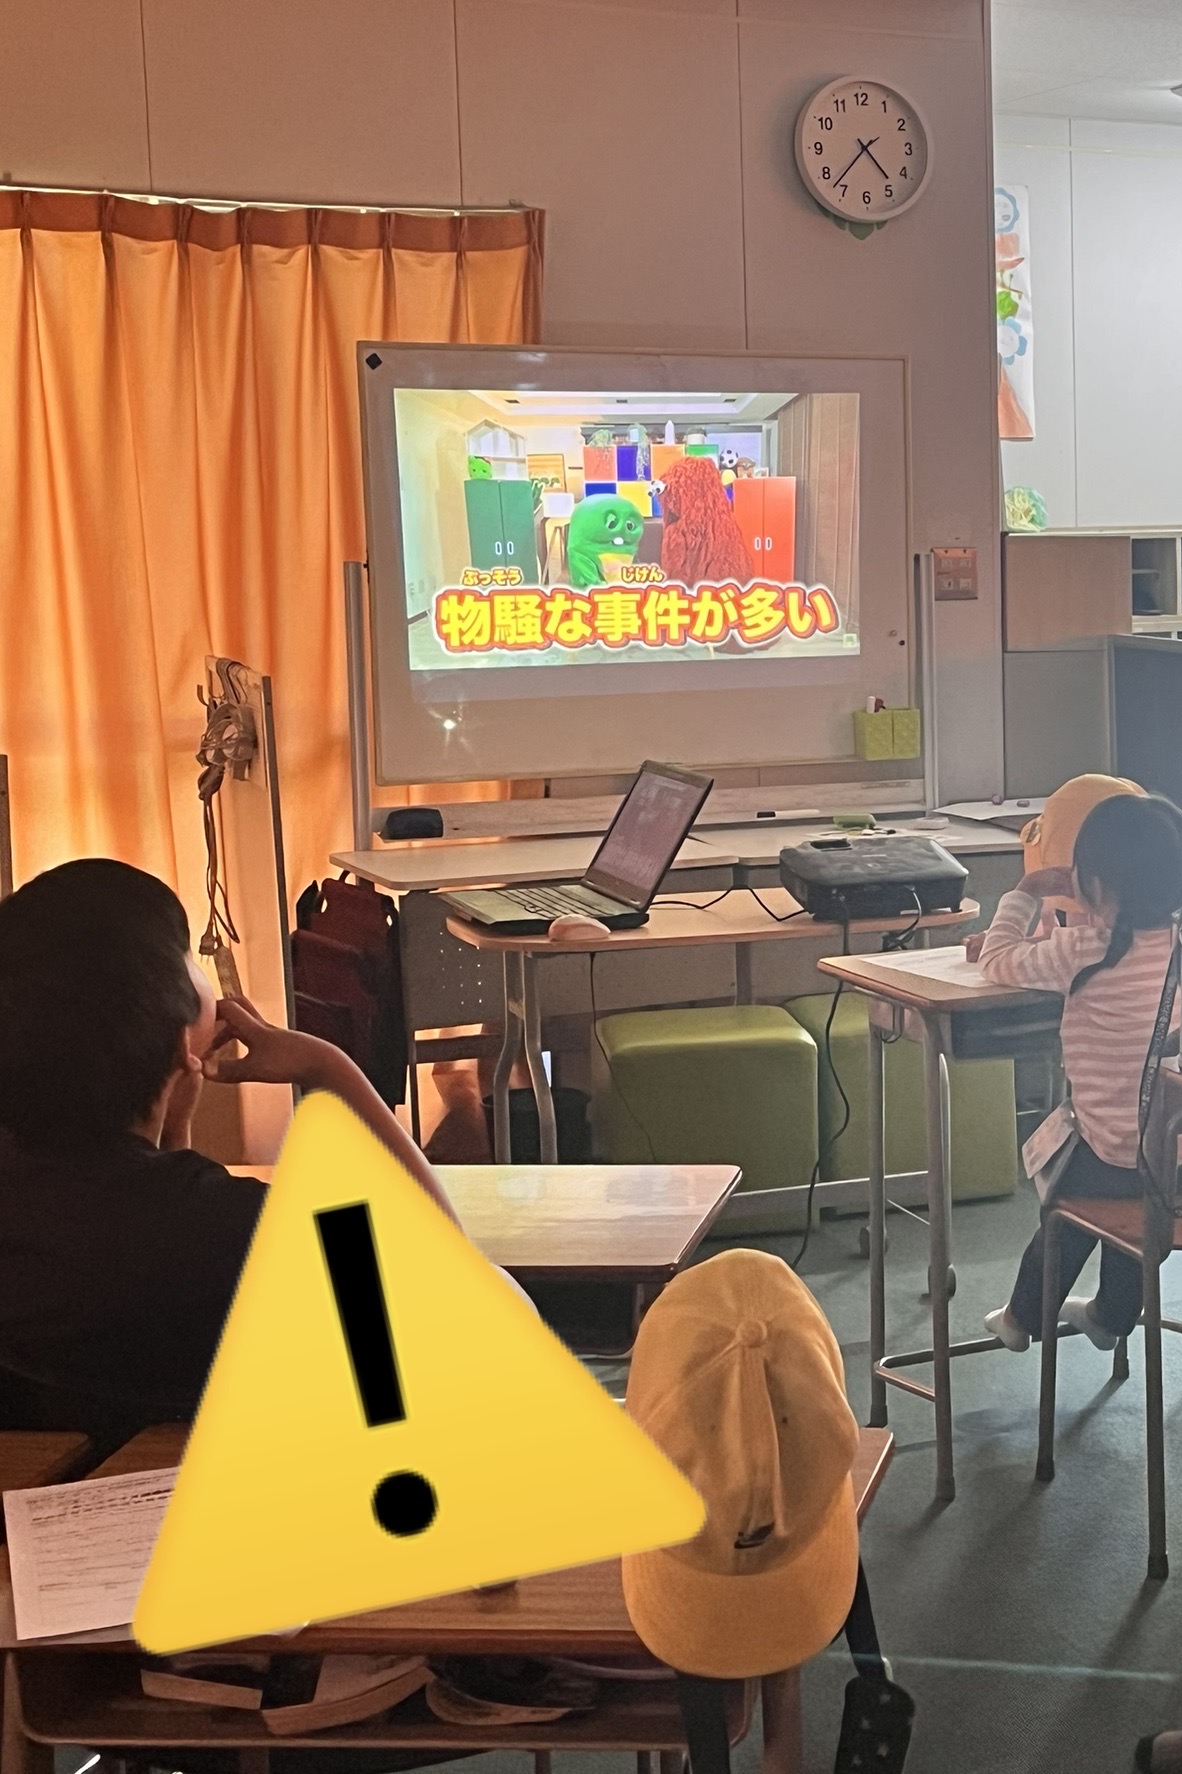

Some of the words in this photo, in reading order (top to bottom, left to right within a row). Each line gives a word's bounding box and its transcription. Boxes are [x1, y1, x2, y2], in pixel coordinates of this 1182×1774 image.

[833, 99, 846, 113] 11
[853, 92, 869, 106] 12
[881, 100, 887, 113] 1
[818, 117, 833, 131] 10
[897, 118, 906, 131] 2
[813, 141, 823, 155] 9
[904, 142, 913, 156] 3
[822, 166, 831, 180] 8
[899, 166, 908, 179] 4
[839, 184, 848, 197] 7
[862, 191, 871, 204] 6
[884, 184, 893, 198] 5
[460, 568, 524, 586] ぶっそう
[620, 566, 664, 583] じけん
[438, 584, 836, 649] 物騒な事件が多い
